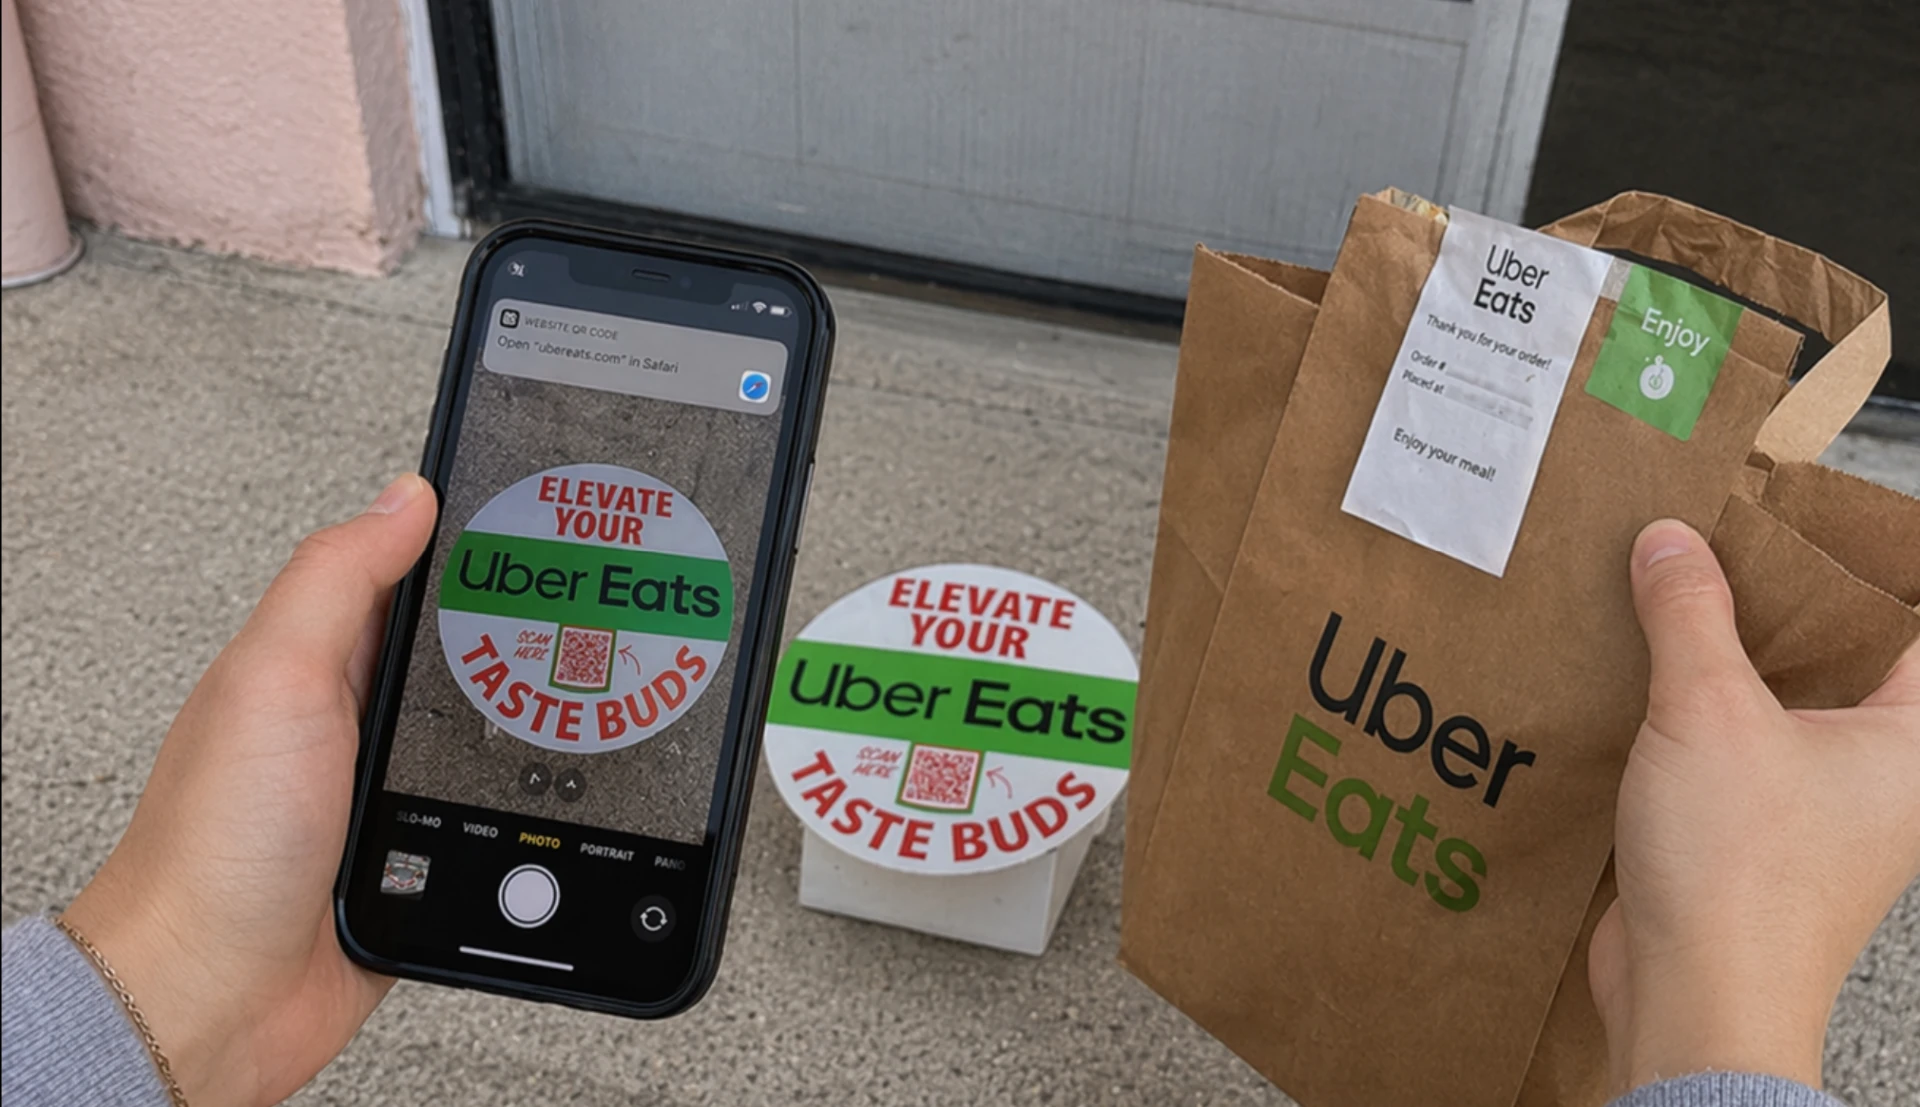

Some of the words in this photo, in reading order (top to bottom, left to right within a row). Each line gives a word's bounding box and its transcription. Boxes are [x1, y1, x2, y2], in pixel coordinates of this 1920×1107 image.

[1486, 244, 1549, 290] Uber
[1473, 277, 1536, 324] Eats
[525, 316, 569, 332] WEBSITE
[589, 327, 618, 341] CODE
[1427, 314, 1456, 335] Thank
[1457, 329, 1476, 342] you
[1476, 332, 1492, 348] for
[1492, 342, 1517, 356] your
[1518, 350, 1553, 371] order!
[1641, 307, 1711, 356] Enjoy
[498, 335, 530, 350] Open
[628, 356, 640, 368] in
[642, 358, 679, 374] Safari
[1411, 350, 1437, 368] Order
[1438, 361, 1447, 371] #
[1402, 369, 1434, 390] Placed
[1433, 380, 1444, 394] at
[1394, 427, 1428, 455] Enjoy
[1426, 445, 1458, 465] your
[1459, 458, 1496, 482] meal!
[538, 476, 673, 518] ELEVATE
[555, 507, 644, 545] YOUR
[459, 549, 589, 601] Uber
[598, 564, 720, 618] Eats
[888, 577, 1076, 630] ELEVATE
[516, 630, 554, 646] SCAN
[910, 613, 1029, 659] YOUR
[461, 634, 583, 741] TASTE
[596, 645, 707, 741] BUDS
[789, 659, 952, 720] Uber
[963, 679, 1126, 744] Eats
[1309, 611, 1537, 808] Uber
[856, 745, 903, 763] SCAN
[792, 750, 934, 860] TASTE
[952, 771, 1096, 862] BUDS
[1267, 713, 1487, 912] Eats
[463, 822, 499, 838] VIDEO
[519, 832, 561, 849] PHOTO
[580, 842, 635, 861] PORTRAIT
[654, 855, 685, 871] PANO
